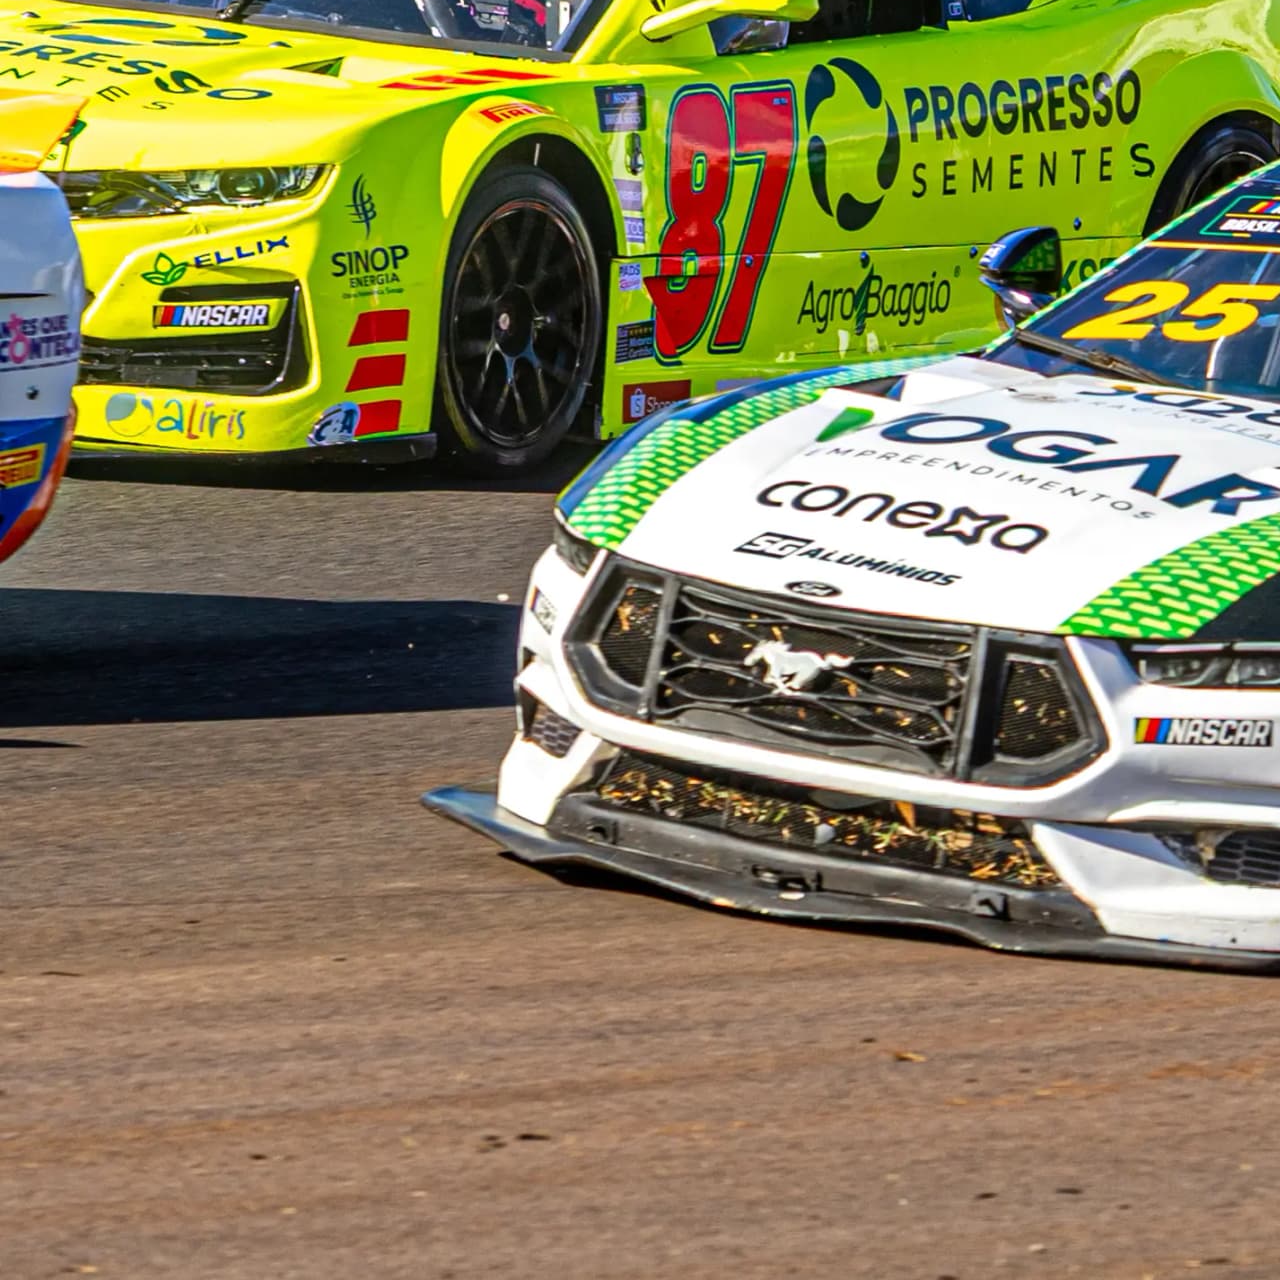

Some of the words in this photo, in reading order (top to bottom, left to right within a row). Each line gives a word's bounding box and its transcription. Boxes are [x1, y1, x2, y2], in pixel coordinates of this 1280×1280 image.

[903, 69, 1142, 143] PROGRESSO
[911, 141, 1157, 199] SEMENTES
[655, 79, 797, 366] 87
[1219, 219, 1277, 233] BRASIL
[194, 235, 289, 267] ELLIX
[331, 244, 409, 277] SINOP
[349, 272, 401, 289] ENERGIA
[181, 305, 269, 327] NASCAR
[756, 479, 1051, 555] conexa
[794, 544, 964, 588] ALUMÍNIOS
[1167, 719, 1272, 747] NASCAR
